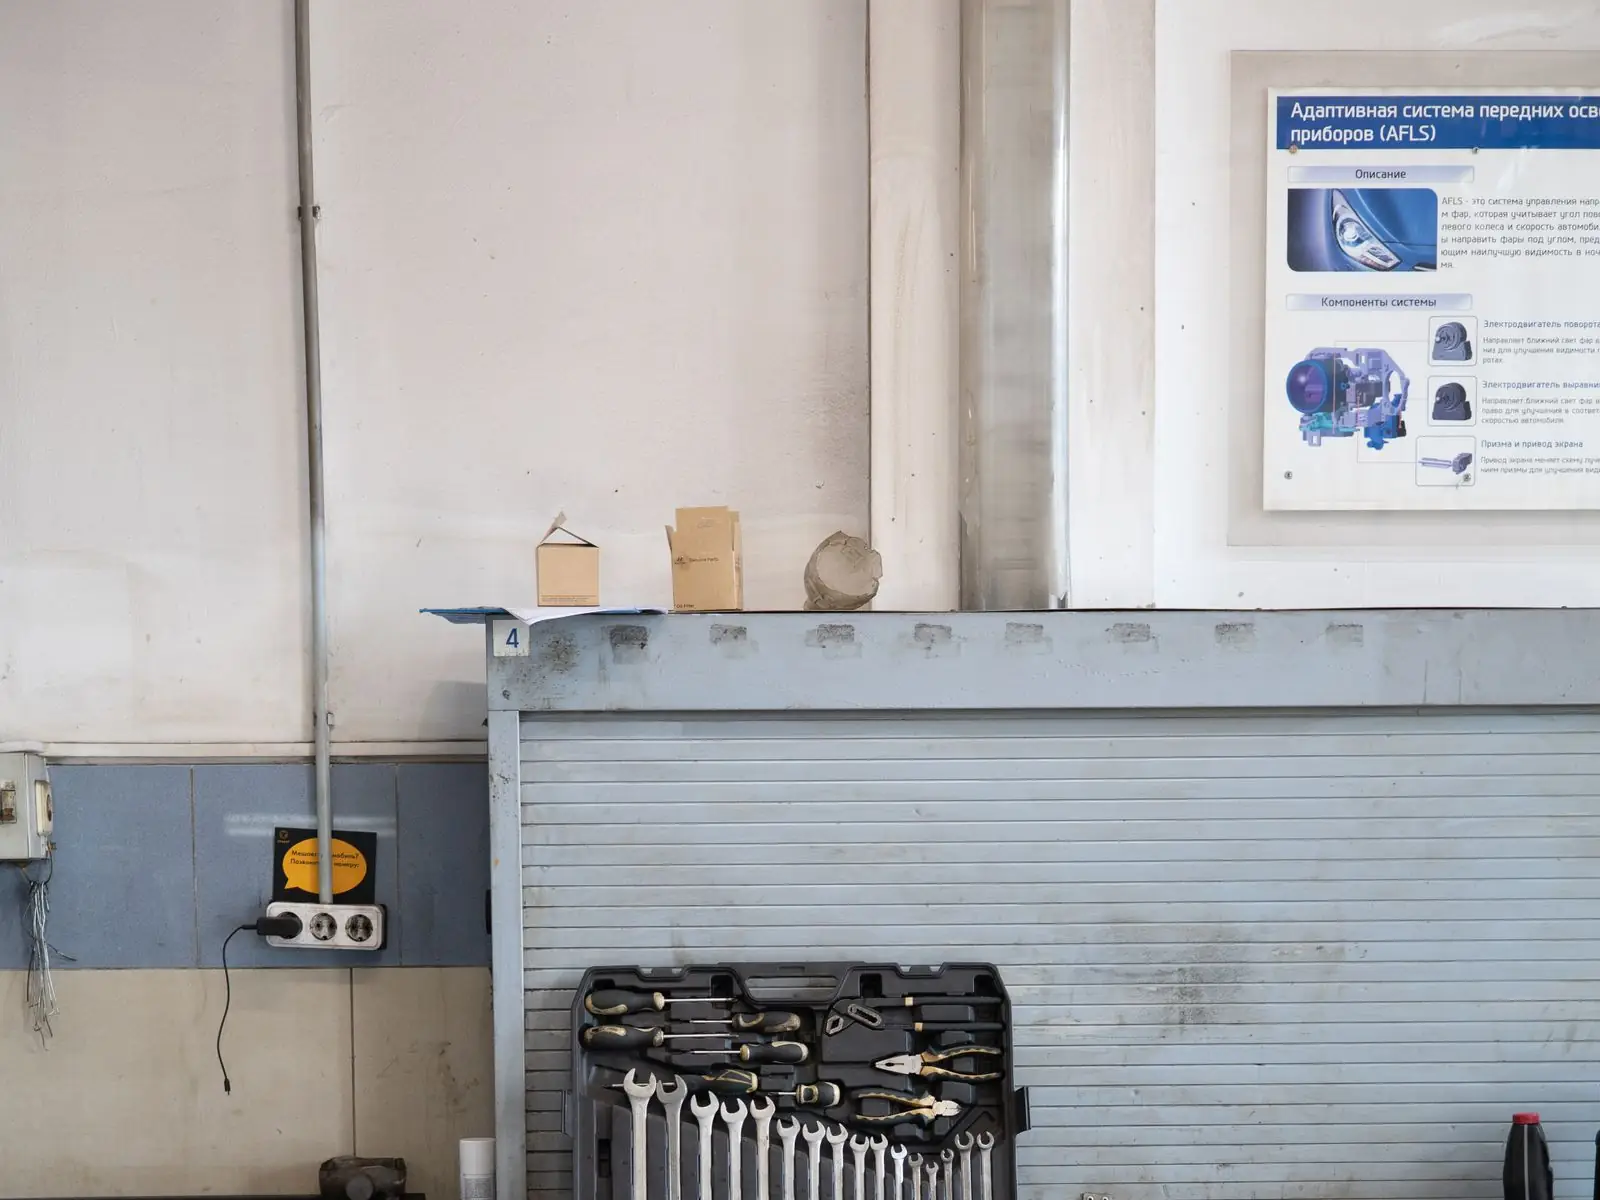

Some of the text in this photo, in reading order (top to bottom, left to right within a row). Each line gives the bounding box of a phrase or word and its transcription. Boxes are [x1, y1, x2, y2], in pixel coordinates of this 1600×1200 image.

[1291, 102, 1397, 120] Адаптивная
[1403, 104, 1474, 118] система
[1480, 104, 1564, 122] передних
[1291, 124, 1436, 144] приборов (AFLS)
[1355, 168, 1407, 180] Описание
[1442, 197, 1463, 205] AFLS
[1526, 198, 1577, 207] управления
[1451, 210, 1471, 219] фар,
[1474, 211, 1508, 219] которая
[1511, 211, 1557, 219] учитывает
[1560, 211, 1580, 219] угол
[1441, 223, 1472, 231] левого
[1474, 223, 1504, 231] колеса
[1516, 223, 1555, 232] скорость
[1557, 222, 1600, 231] автомоби
[1452, 236, 1497, 245] направить
[1499, 235, 1525, 245] фары
[1527, 236, 1544, 244] под
[1547, 236, 1577, 245] углом,
[1440, 249, 1468, 257] ющим
[1471, 248, 1521, 258] наилучшую
[1525, 249, 1573, 257] видимость
[1321, 296, 1437, 308] Компоненты системы
[1483, 319, 1561, 329] Электродвигатель
[1482, 380, 1561, 390] Электродвигатель
[1481, 439, 1512, 449] Призма
[1522, 440, 1553, 449] привод
[1554, 440, 1584, 449] экрана
[505, 627, 520, 648] 4
